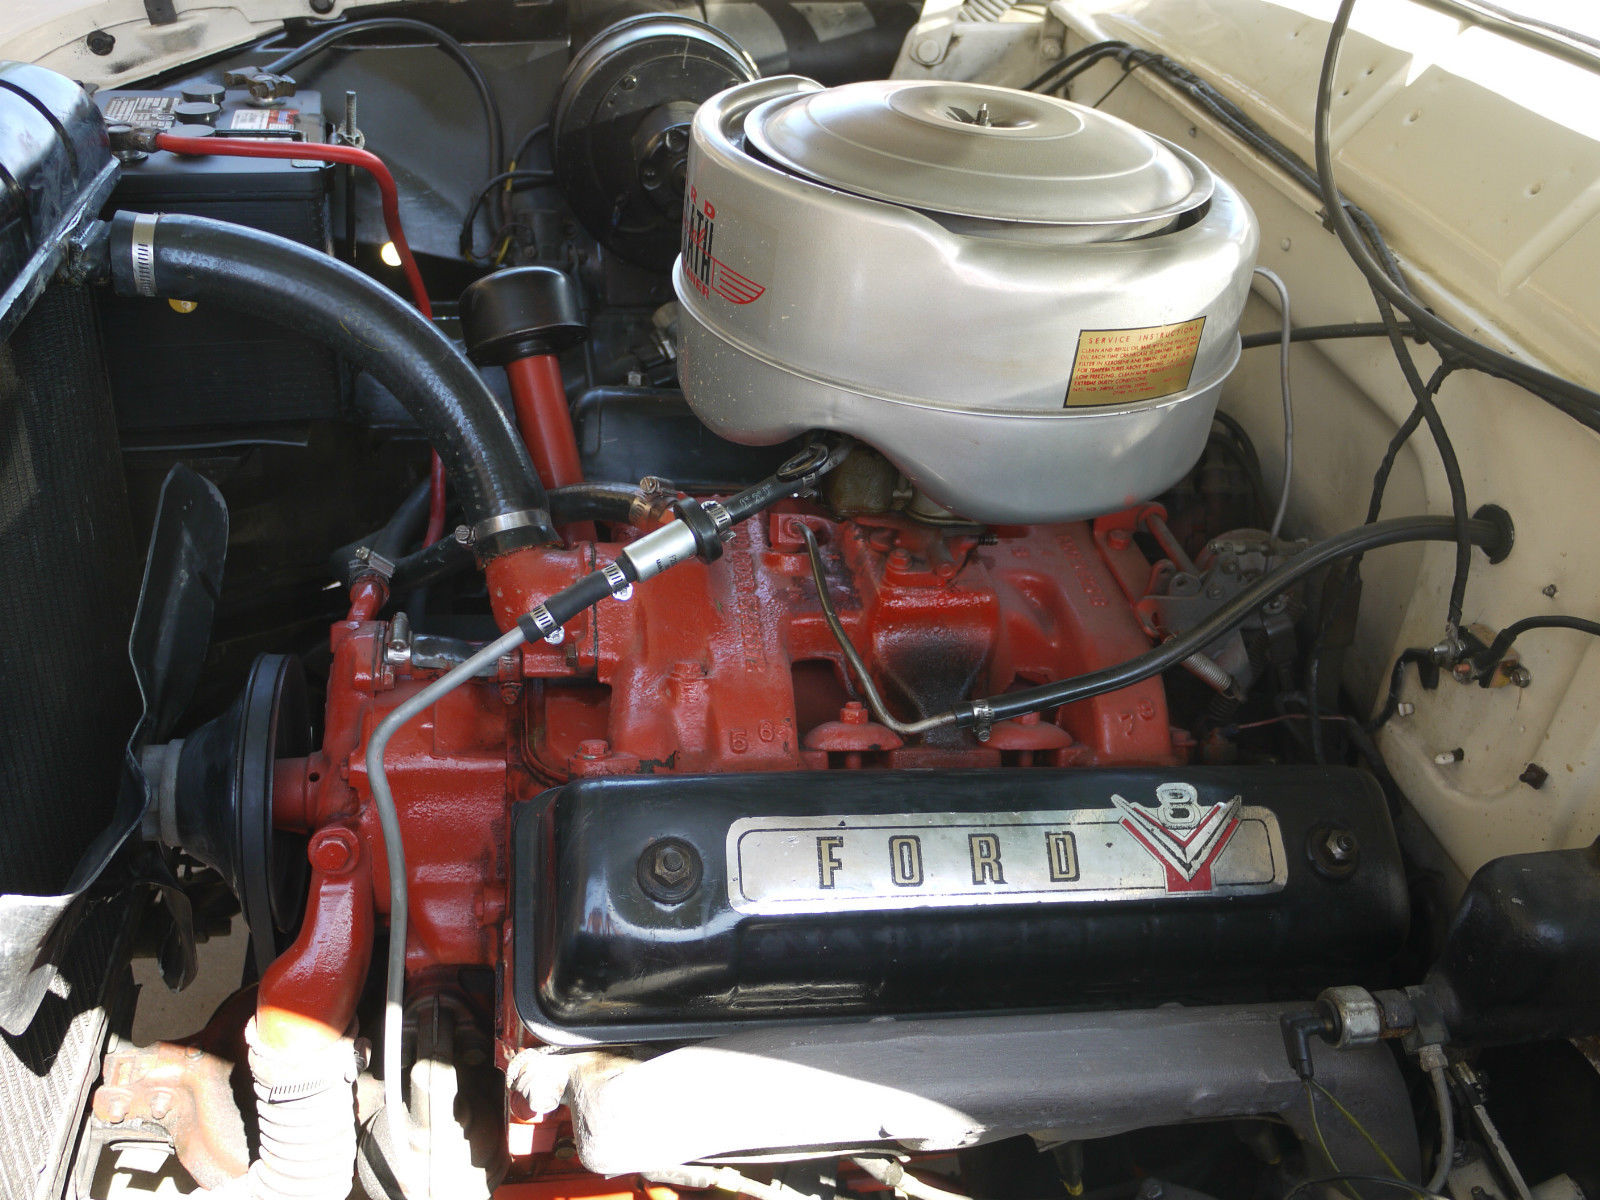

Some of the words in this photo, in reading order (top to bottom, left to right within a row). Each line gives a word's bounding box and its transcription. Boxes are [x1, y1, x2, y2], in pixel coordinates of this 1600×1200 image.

[1089, 336, 1130, 344] SERVICE
[728, 728, 749, 754] 5
[758, 719, 776, 742] 6
[816, 830, 1081, 890] FORD
